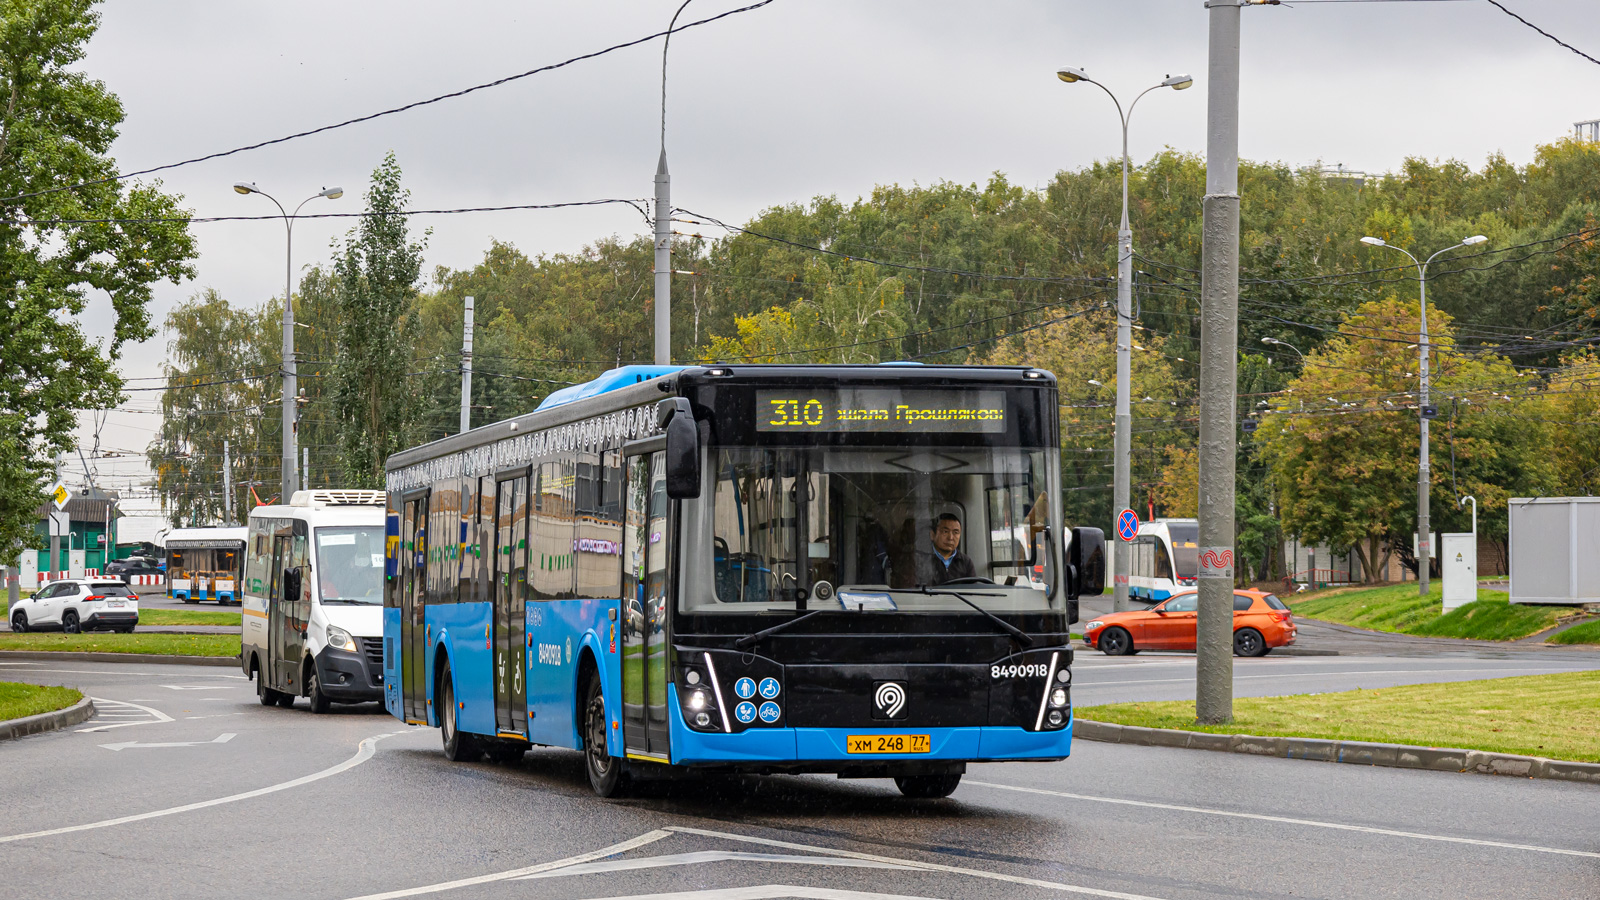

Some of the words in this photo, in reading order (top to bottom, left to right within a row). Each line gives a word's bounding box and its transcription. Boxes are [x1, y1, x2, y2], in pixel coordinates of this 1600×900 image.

[769, 398, 824, 426] 310
[538, 642, 562, 666] 8490918
[991, 663, 1048, 679] 8490918
[877, 736, 904, 751] 248
[912, 735, 926, 747] 77
